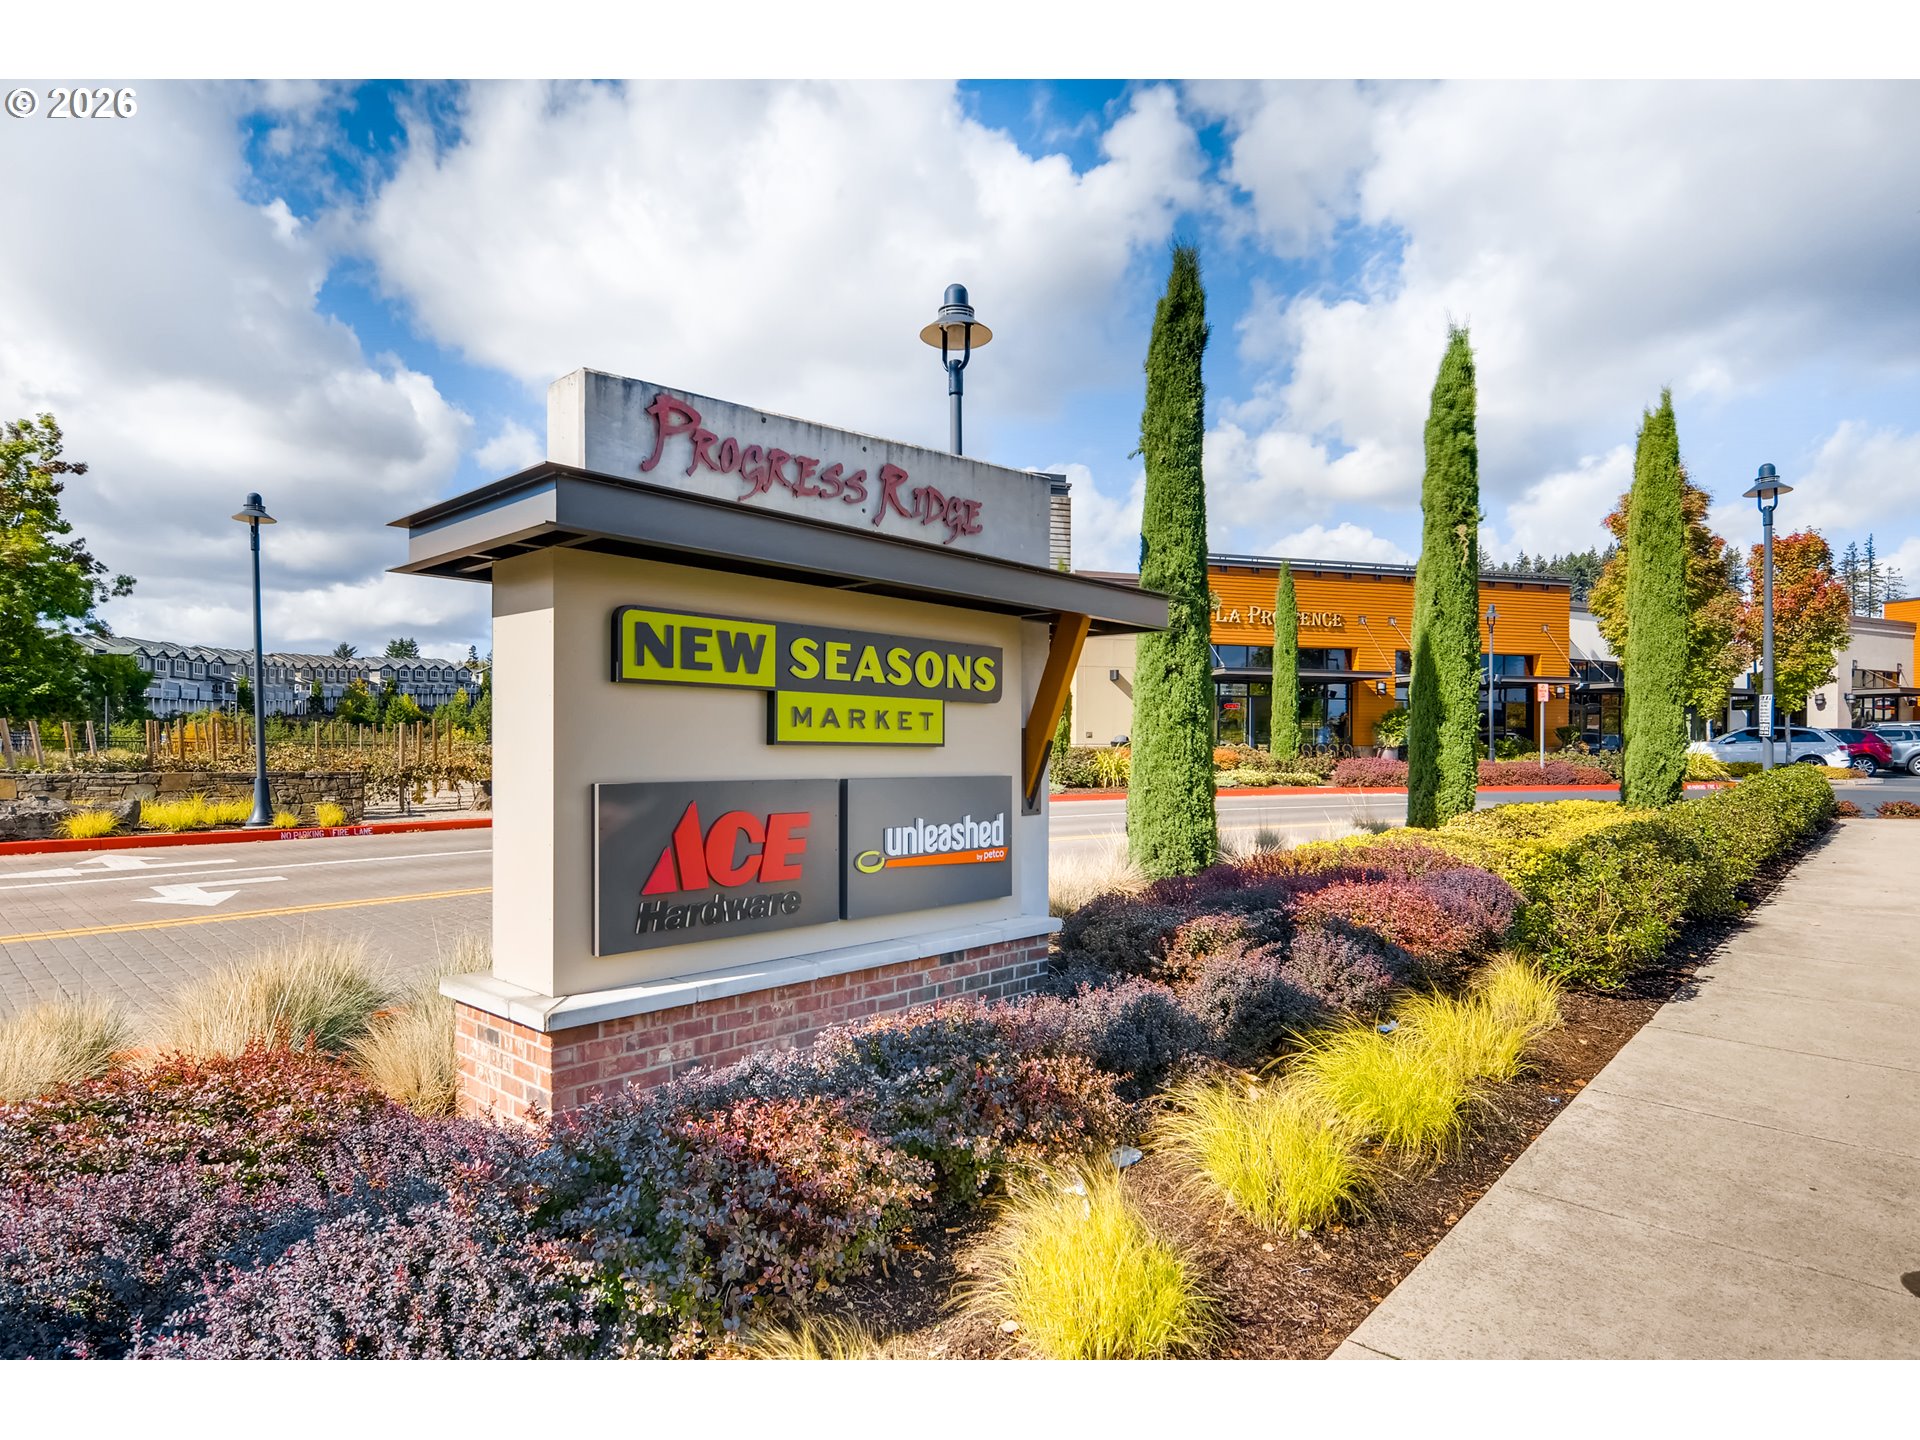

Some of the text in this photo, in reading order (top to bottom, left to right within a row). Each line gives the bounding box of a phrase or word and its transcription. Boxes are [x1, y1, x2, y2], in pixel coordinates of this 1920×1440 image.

[1248, 605, 1343, 627] PRENCE
[634, 621, 996, 693] NEW SEASONS
[791, 705, 934, 731] MARKET
[332, 828, 349, 837] FIRE
[353, 827, 374, 835] LANE
[641, 799, 811, 895] ACE
[884, 812, 1004, 856] unleashed
[983, 849, 1005, 861] petco
[635, 890, 802, 935] Hardware
